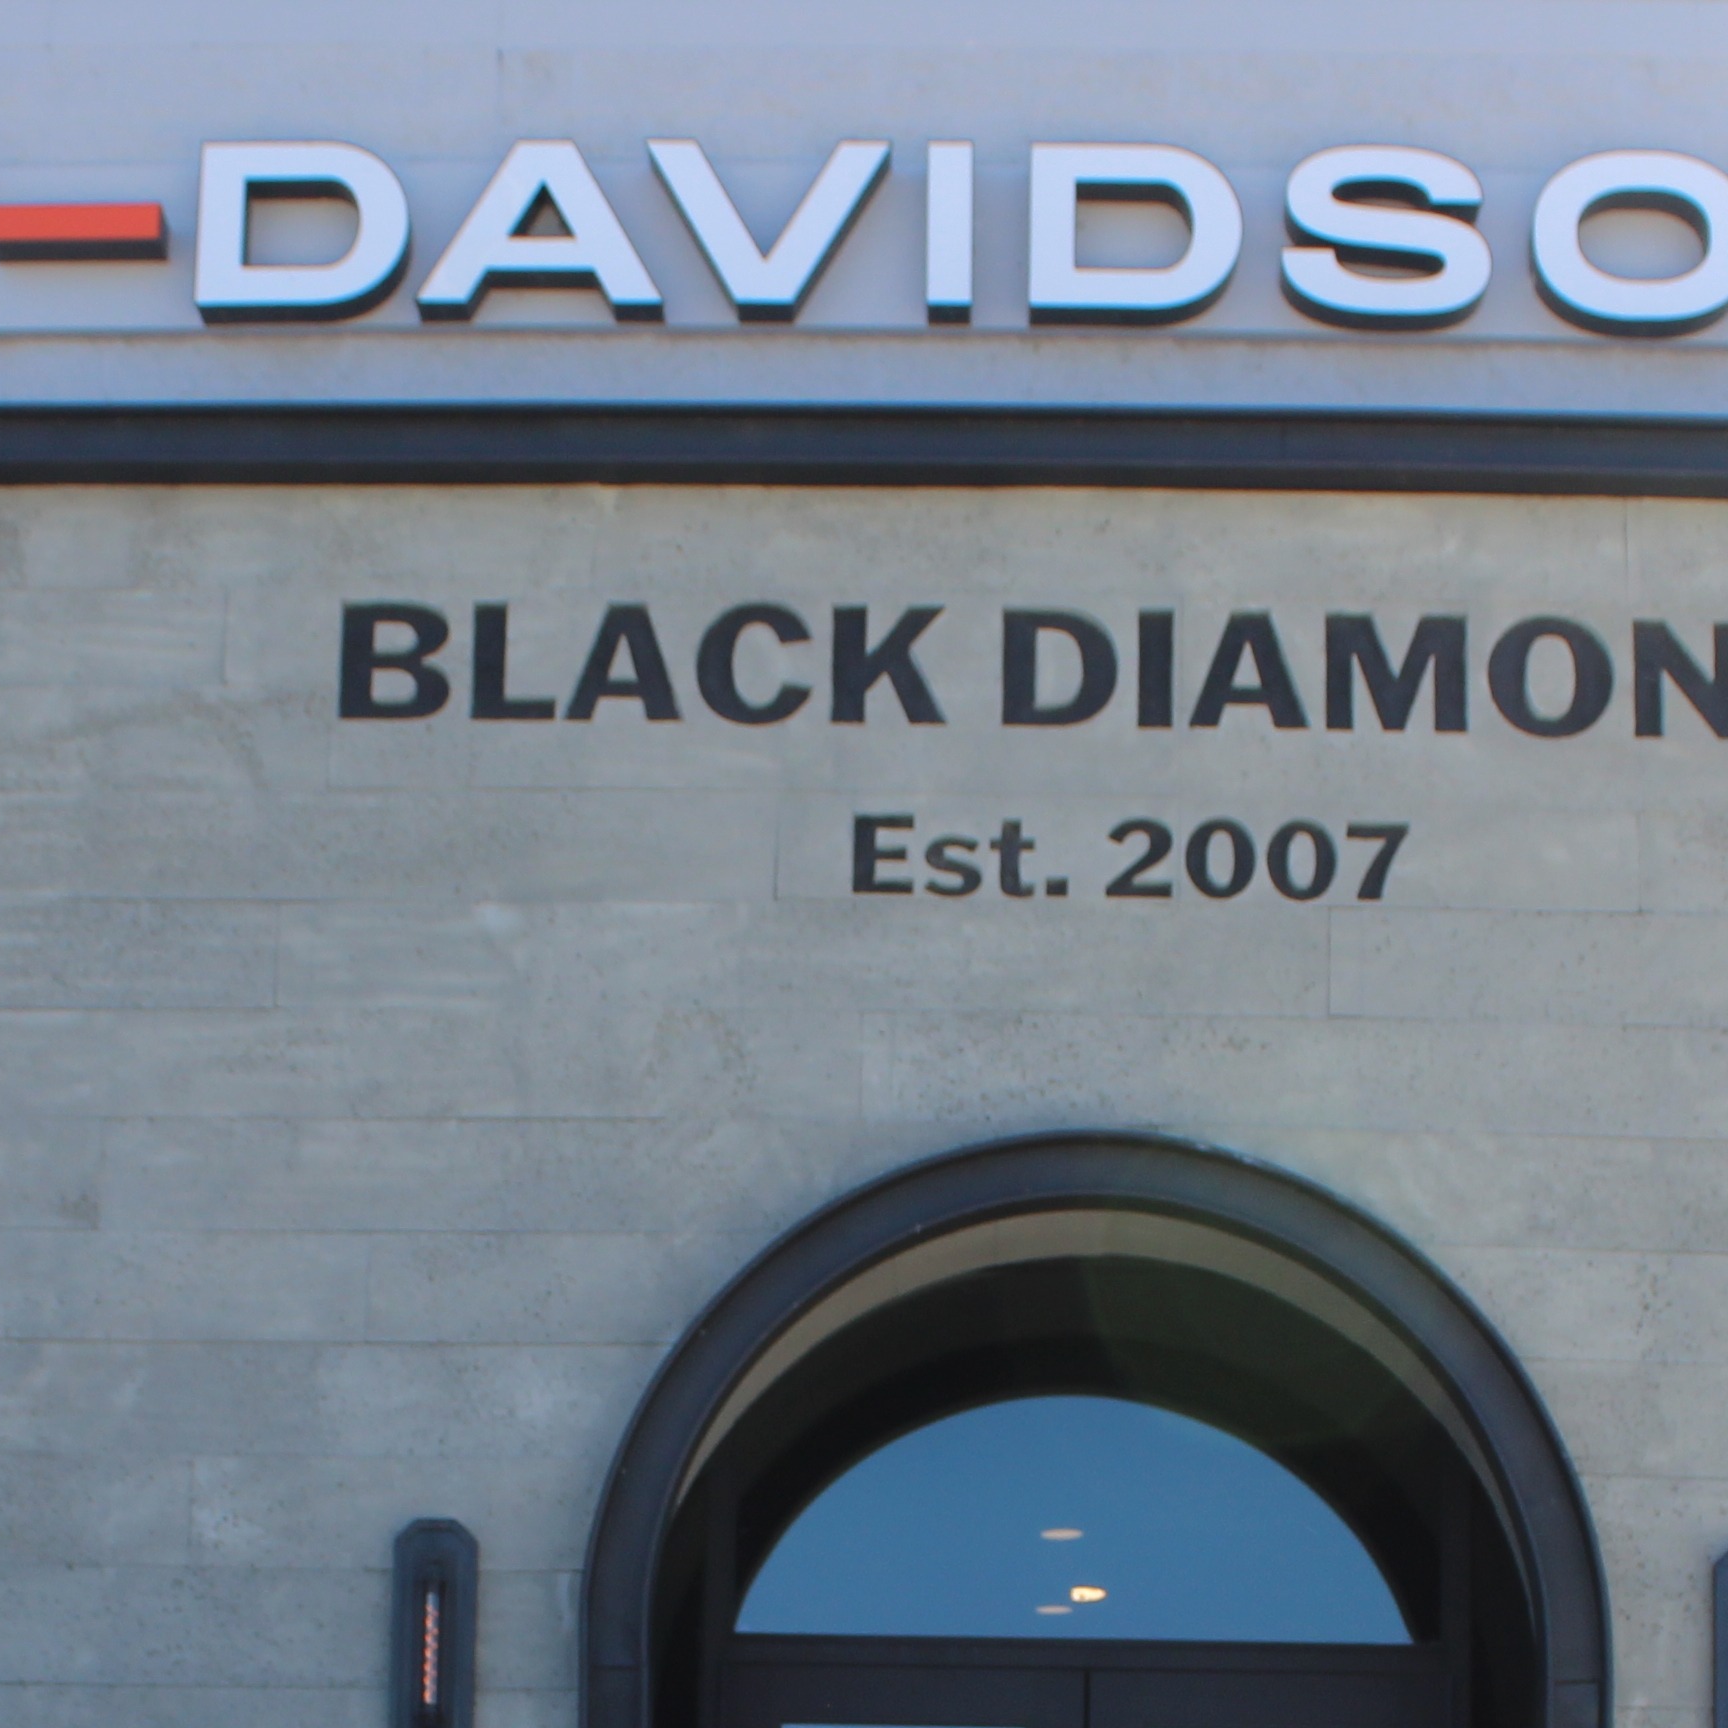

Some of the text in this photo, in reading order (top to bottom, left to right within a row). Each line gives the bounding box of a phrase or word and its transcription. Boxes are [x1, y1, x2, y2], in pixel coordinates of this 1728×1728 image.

[338, 601, 947, 723] BLACK
[852, 812, 1413, 905] Est. 2007
